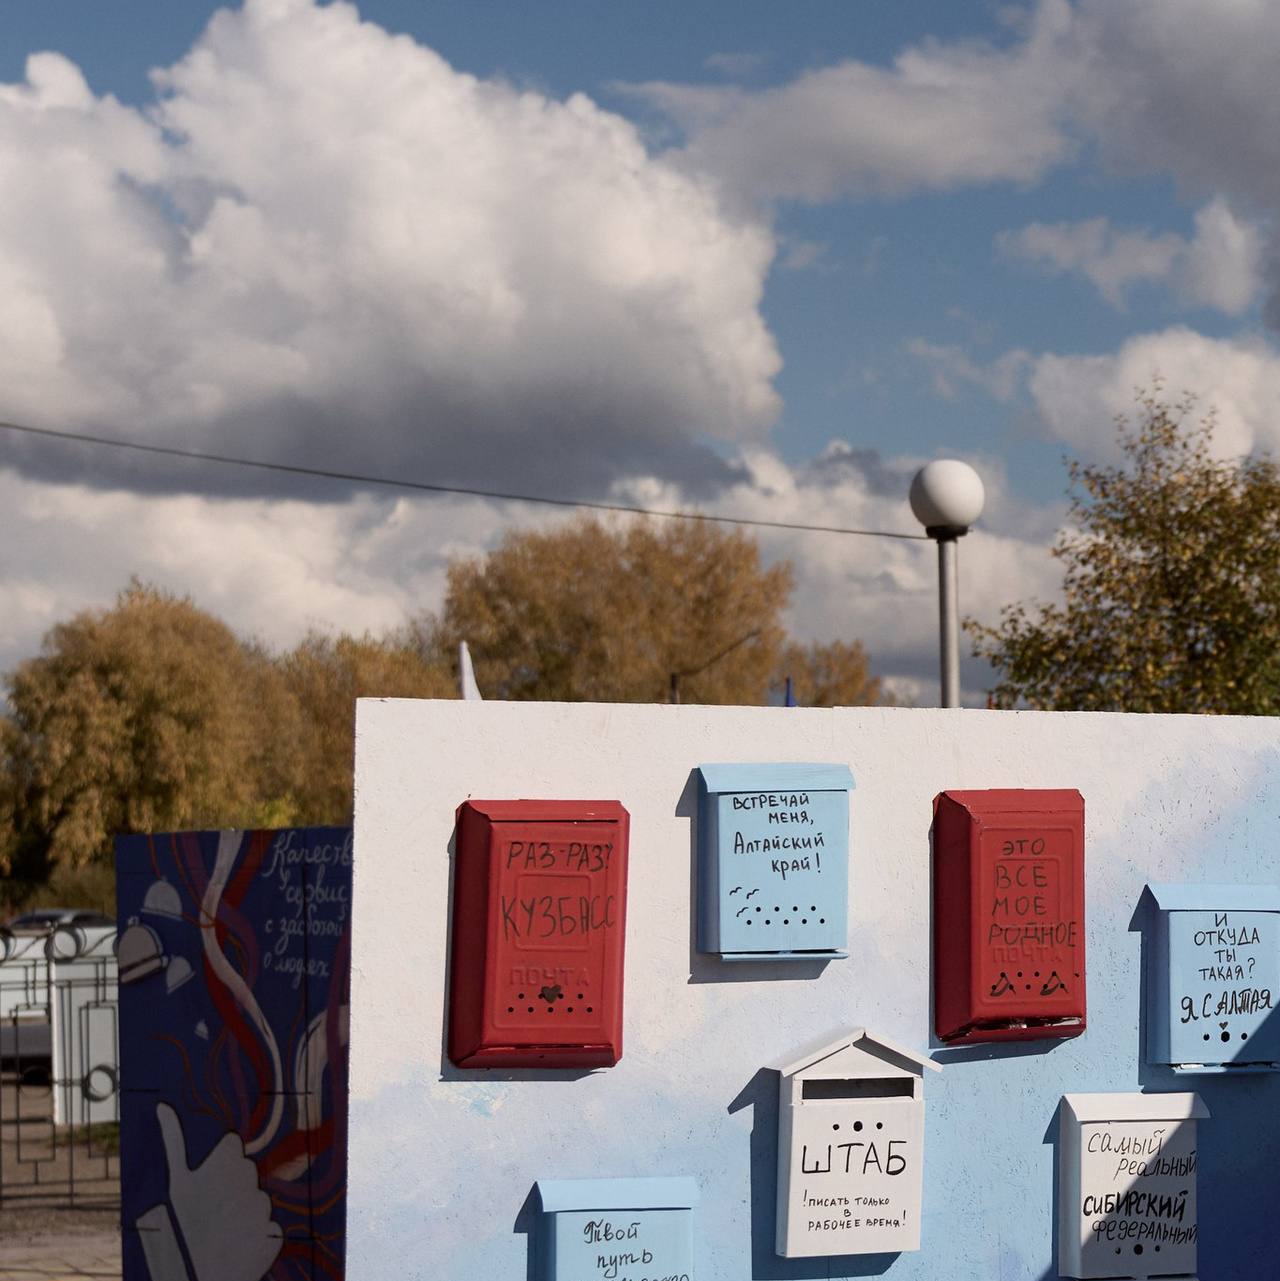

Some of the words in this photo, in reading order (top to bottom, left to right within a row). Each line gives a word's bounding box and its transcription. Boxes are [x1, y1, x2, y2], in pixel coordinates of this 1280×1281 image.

[732, 792, 811, 811] ВСТРЕЧАЙ
[768, 809, 815, 826] МЕНЯ,
[1002, 837, 1046, 856] ЭТО
[994, 858, 1048, 889] ВСЁ
[991, 892, 1047, 918] МОЁ
[501, 894, 616, 941] КУЗБАСС
[1214, 913, 1228, 928] И
[988, 921, 1078, 948] РОДНОЕ
[1194, 926, 1260, 947] ОТКУДА
[1214, 948, 1236, 963] ТЫ
[509, 965, 590, 988] ПОЧТА
[1198, 957, 1256, 982] ТАКАЯ?
[1180, 997, 1199, 1025] Я
[1218, 988, 1274, 1016] АЛТАЯ
[801, 1141, 907, 1176] ШТАБ
[843, 1208, 851, 1218] В
[854, 1197, 890, 1207] ТОЛЬКО
[584, 1219, 641, 1244] Твой
[807, 1220, 861, 1232] РАБОЧЕЕ
[866, 1210, 906, 1228] ВРЕМЯ!
[597, 1249, 653, 1278] путь
